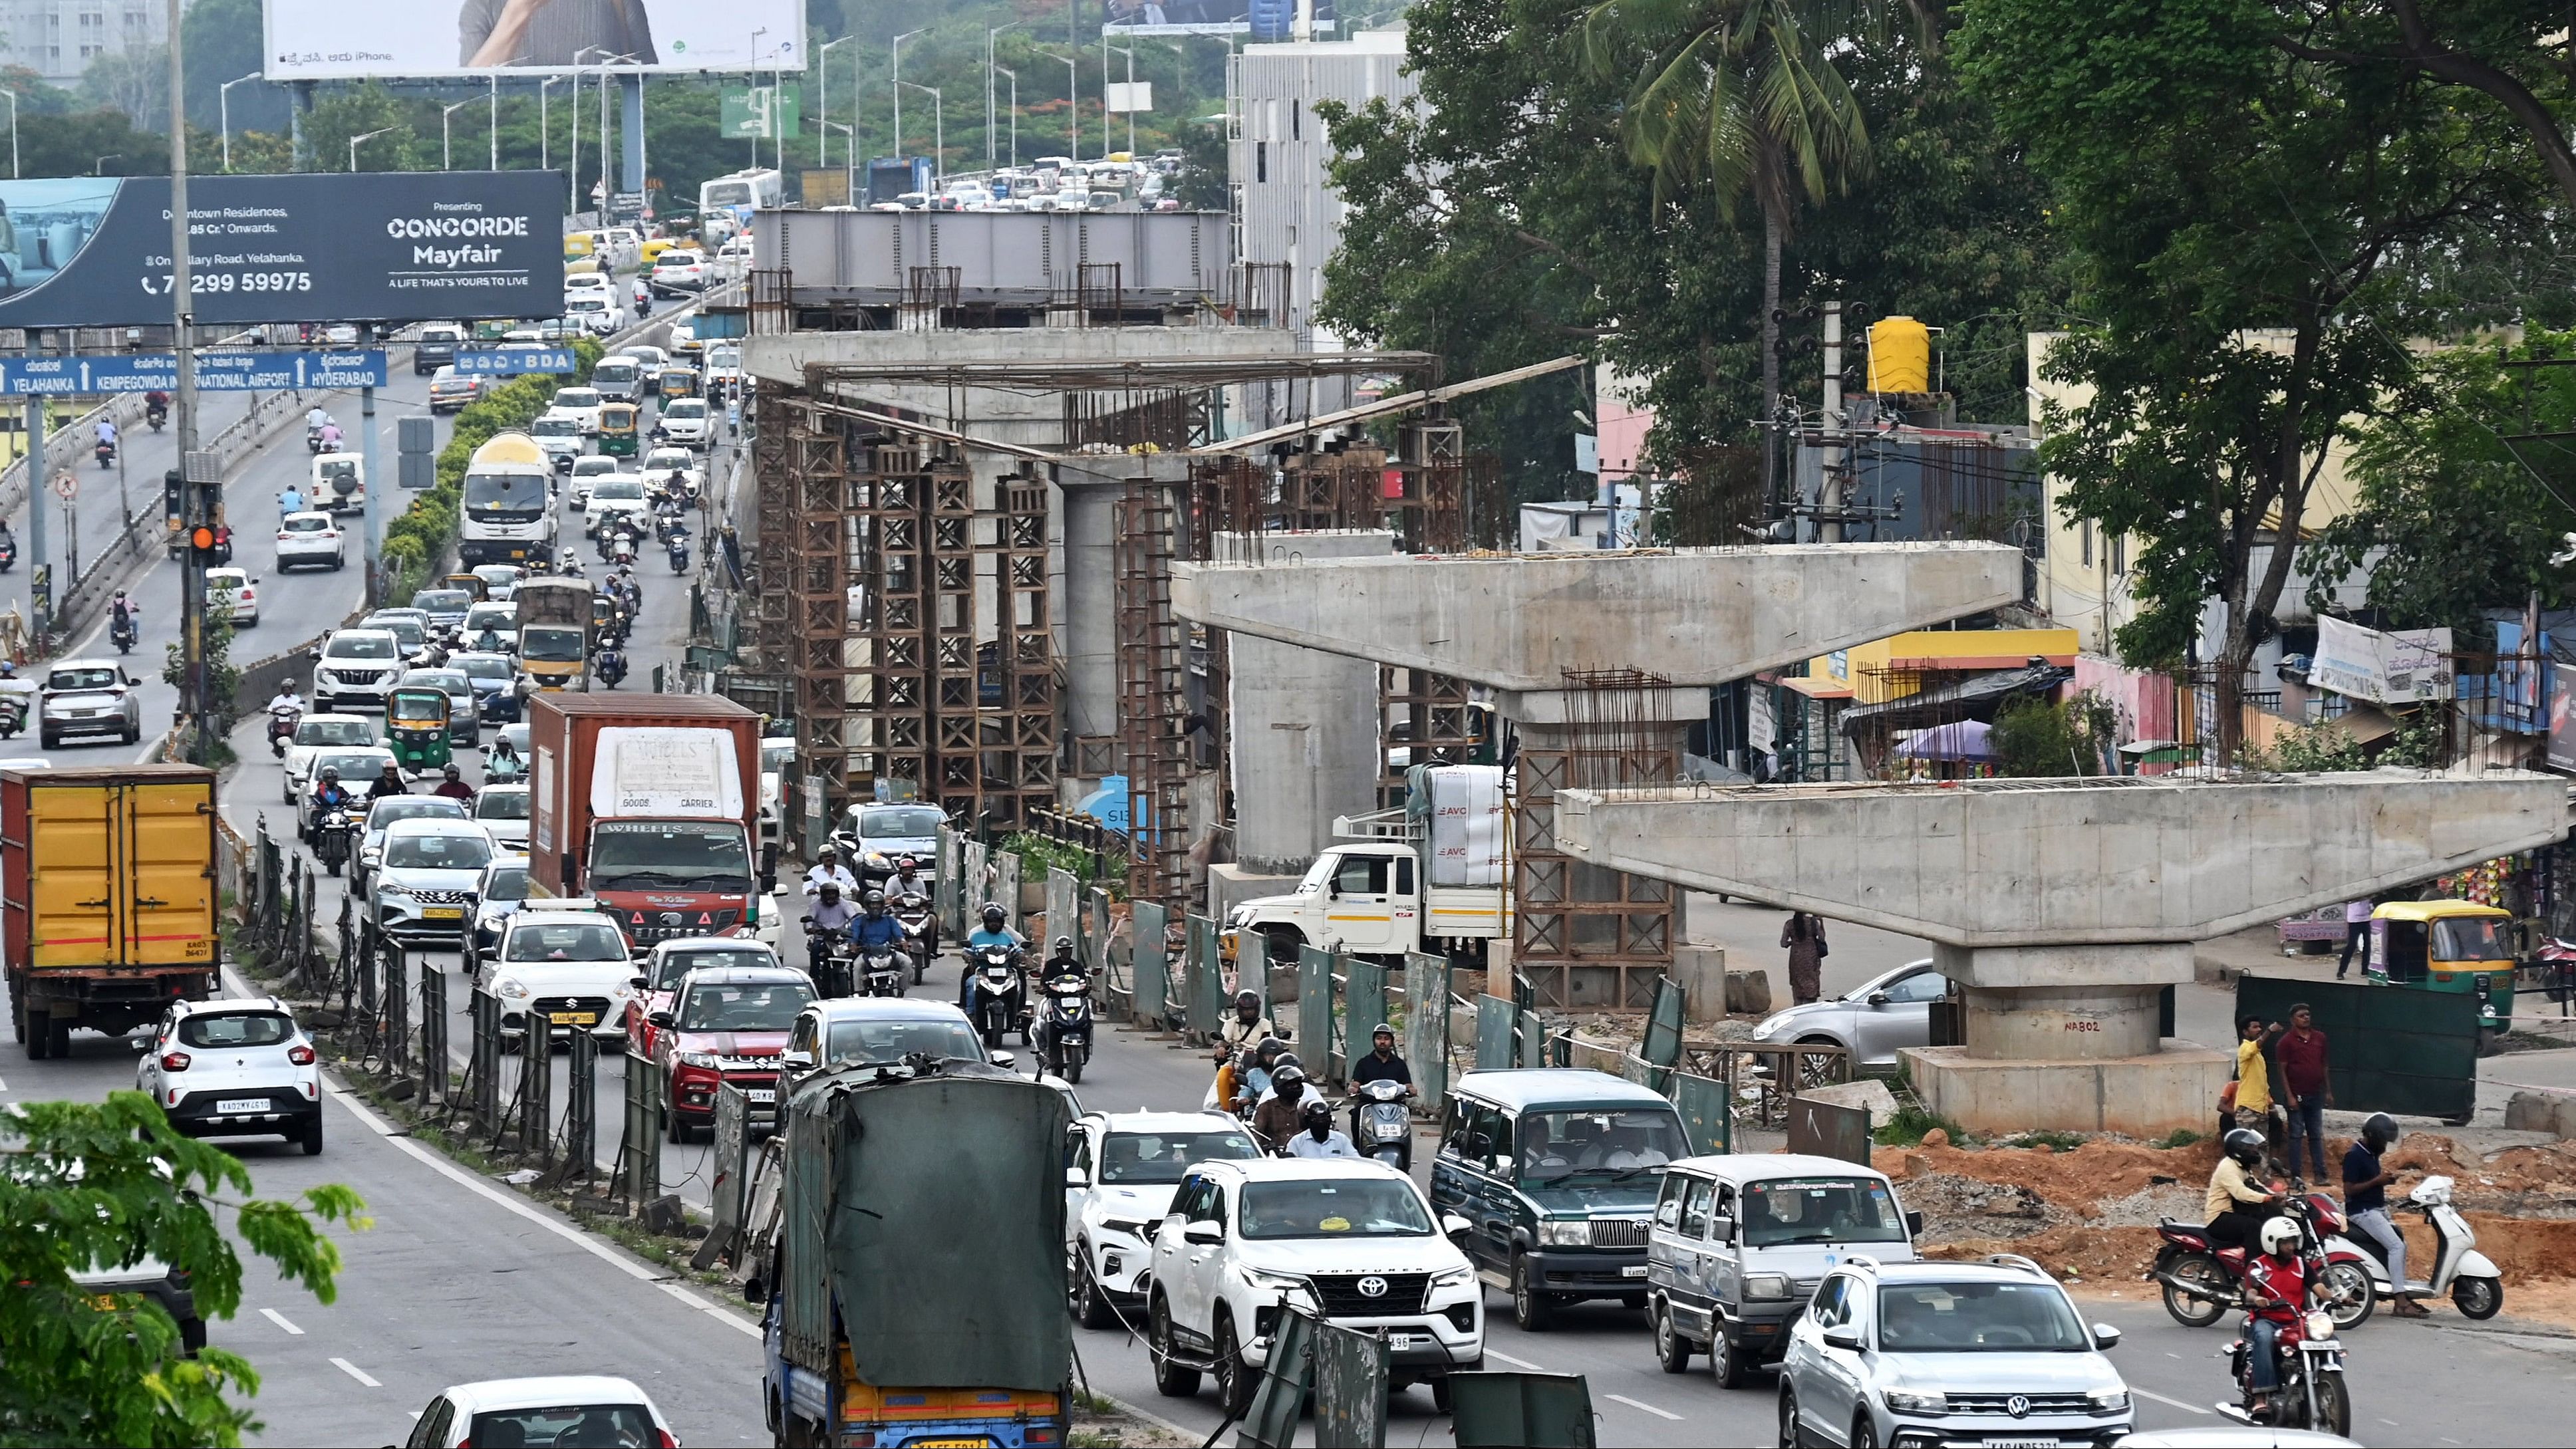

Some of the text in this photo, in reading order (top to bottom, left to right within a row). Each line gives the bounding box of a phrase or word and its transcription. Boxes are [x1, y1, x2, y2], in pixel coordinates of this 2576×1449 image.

[355, 51, 394, 61] iPhone.
[162, 205, 288, 219] Dntown Residences,
[433, 201, 482, 211] Presenting
[227, 223, 278, 233] Onwards.
[386, 216, 529, 238] CONCORDE
[155, 256, 171, 266] On
[187, 255, 212, 267] llary
[413, 243, 502, 269] Mayfair
[162, 272, 311, 293] 7299 59975
[388, 276, 529, 288] A LIFE THAT'S YOURS TO LIVE
[525, 354, 567, 368] BDA
[12, 378, 74, 392] YELAHANKA
[96, 374, 167, 390] KEMPEGOWDA
[168, 373, 246, 390] INRNATIONAL
[311, 370, 374, 386] HYDERABAD
[680, 799, 714, 808] CARRIER
[635, 928, 709, 938] EICHER
